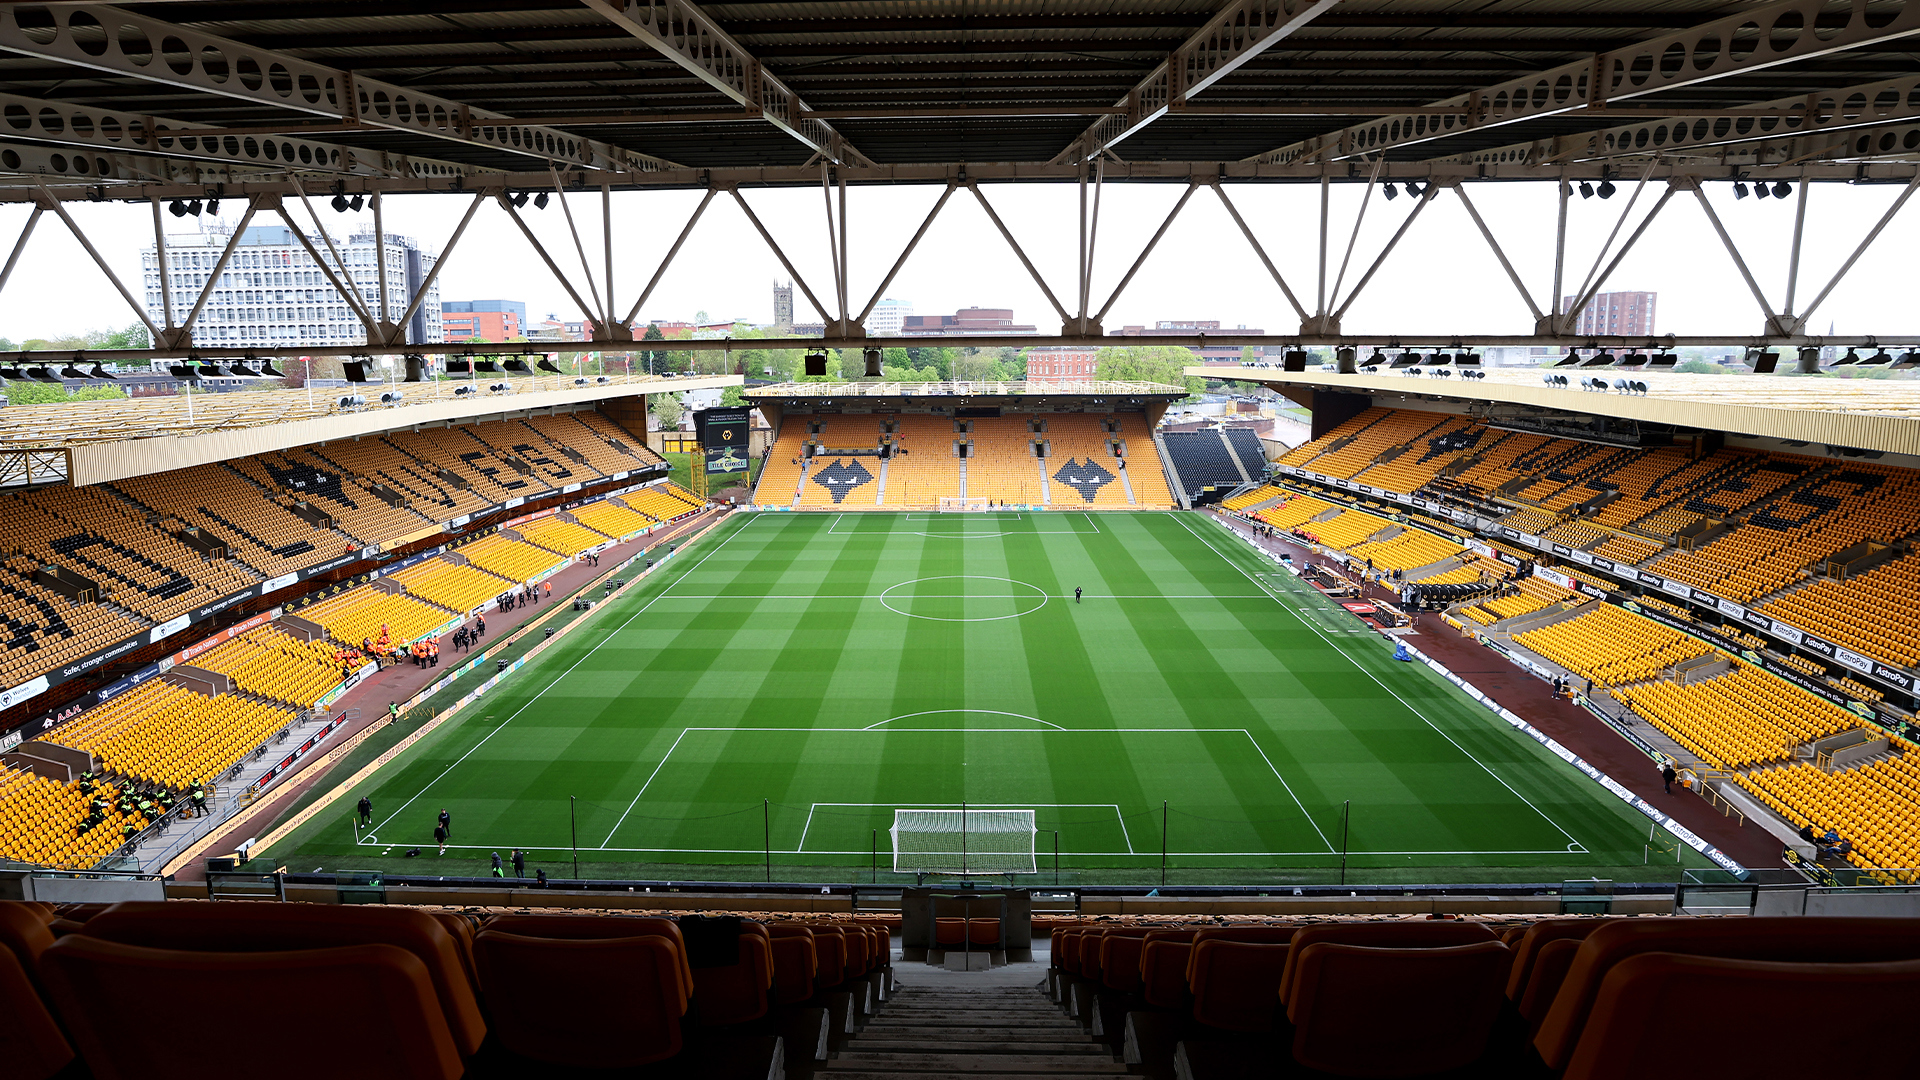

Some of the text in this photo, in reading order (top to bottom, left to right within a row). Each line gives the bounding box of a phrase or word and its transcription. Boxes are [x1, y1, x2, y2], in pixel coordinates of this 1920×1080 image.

[1501, 552, 1521, 567] AstroPay
[1540, 567, 1562, 584] AstroPay
[1640, 573, 1661, 586] AstroPay
[1581, 584, 1608, 601] AstroPay
[1665, 580, 1688, 595] AstroPay
[200, 590, 253, 616] Safer, stronger communities
[1693, 591, 1715, 605] AstroPay
[1721, 602, 1742, 616] AstroPay
[233, 616, 263, 635] Trade Nation
[1745, 613, 1770, 628] AstroPay
[1774, 624, 1799, 641] AstroPay
[189, 636, 219, 656] Trade Nation
[1805, 636, 1833, 655] AstroPay
[63, 640, 138, 677] Safer, stronger communities
[1839, 651, 1869, 670] AstroPay
[1766, 661, 1783, 676] Staying
[1783, 670, 1798, 682] ahead
[1803, 679, 1812, 690] the
[1812, 685, 1827, 697] game
[1832, 693, 1844, 705] tiles
[1875, 665, 1910, 688] AstroPay
[314, 726, 329, 743] 12BET
[1525, 726, 1548, 743] AstroPay
[295, 740, 312, 758] 12BET
[1550, 740, 1572, 760] AstroPay
[275, 755, 293, 774] 12BET
[1575, 759, 1601, 780] AstroPay
[1605, 777, 1631, 799] AstroPay
[1635, 799, 1666, 822] AstroPay
[1670, 822, 1702, 847] AstroPay
[182, 848, 198, 863] online
[198, 841, 209, 851] now
[251, 845, 264, 856] now
[1707, 848, 1745, 876] AstroPay
